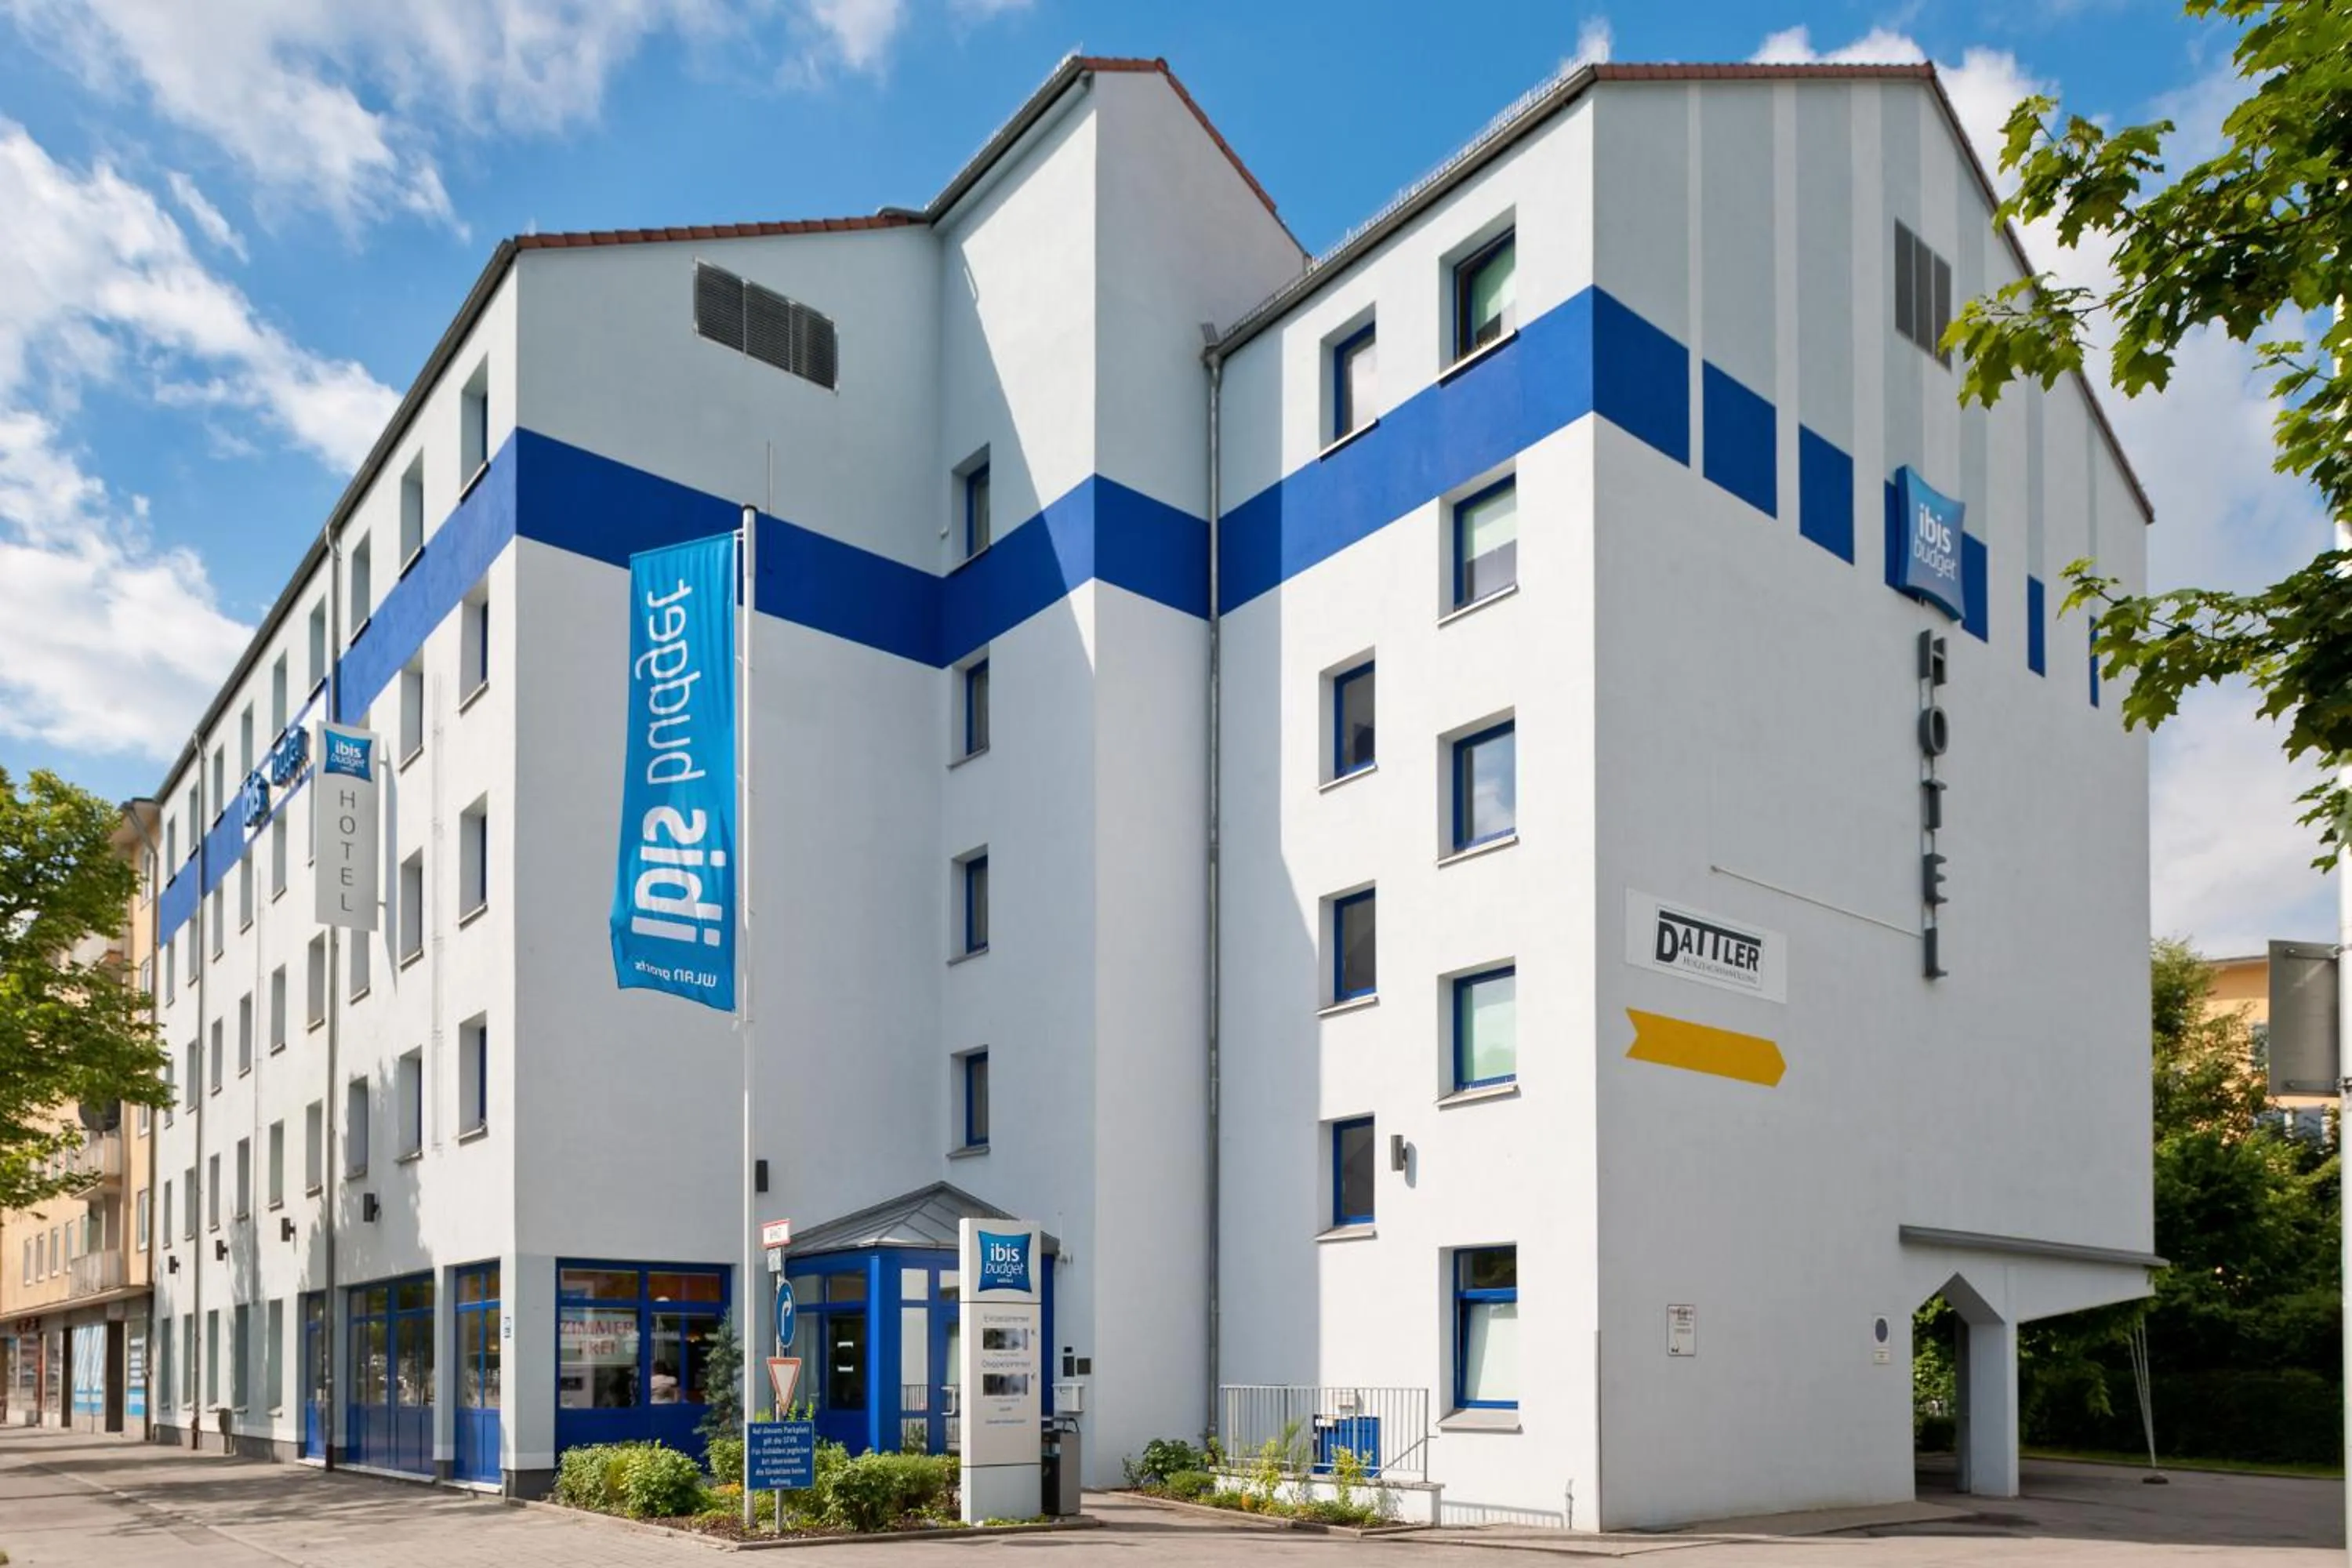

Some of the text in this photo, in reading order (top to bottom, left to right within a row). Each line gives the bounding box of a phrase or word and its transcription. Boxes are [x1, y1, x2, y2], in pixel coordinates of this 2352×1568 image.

[1919, 503, 1951, 554] ibis
[1914, 535, 1957, 581] budget
[336, 739, 361, 758] ibis
[1918, 629, 1947, 978] HOTEL
[339, 789, 356, 912] HOTEL
[1656, 910, 1761, 971] DATTLER
[985, 1261, 1024, 1277] budget
[990, 1243, 1020, 1261] ibis
